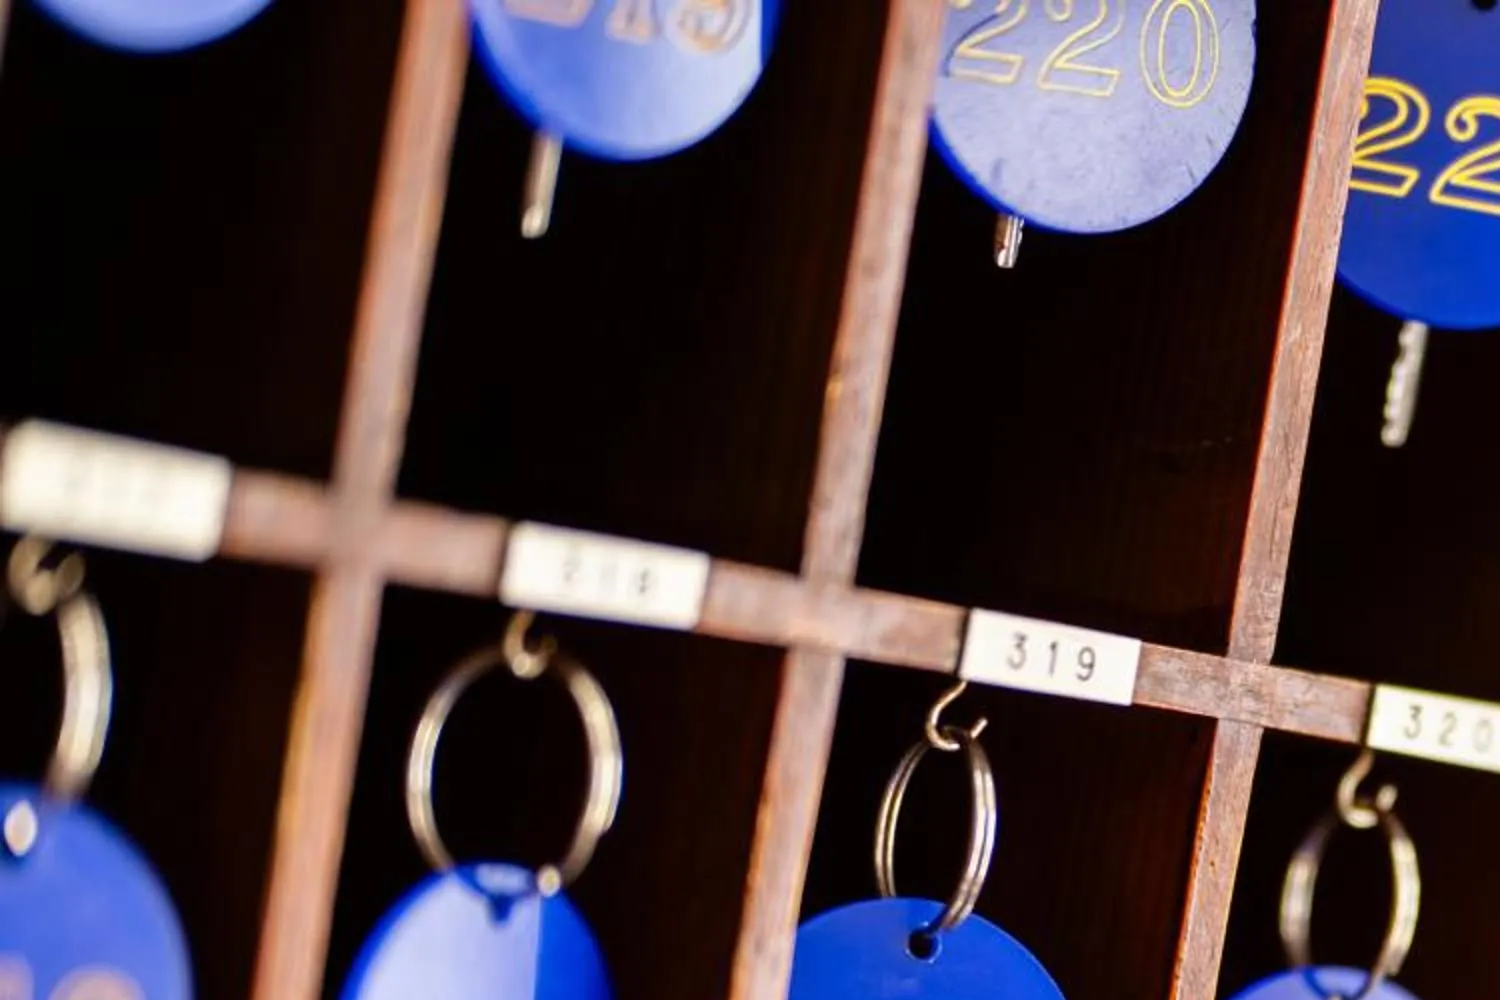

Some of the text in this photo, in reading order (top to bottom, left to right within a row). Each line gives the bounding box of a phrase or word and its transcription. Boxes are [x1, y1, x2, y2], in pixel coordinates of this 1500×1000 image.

[943, 0, 1219, 109] 220
[1006, 631, 1097, 683] 319
[1403, 704, 1494, 754] 320
